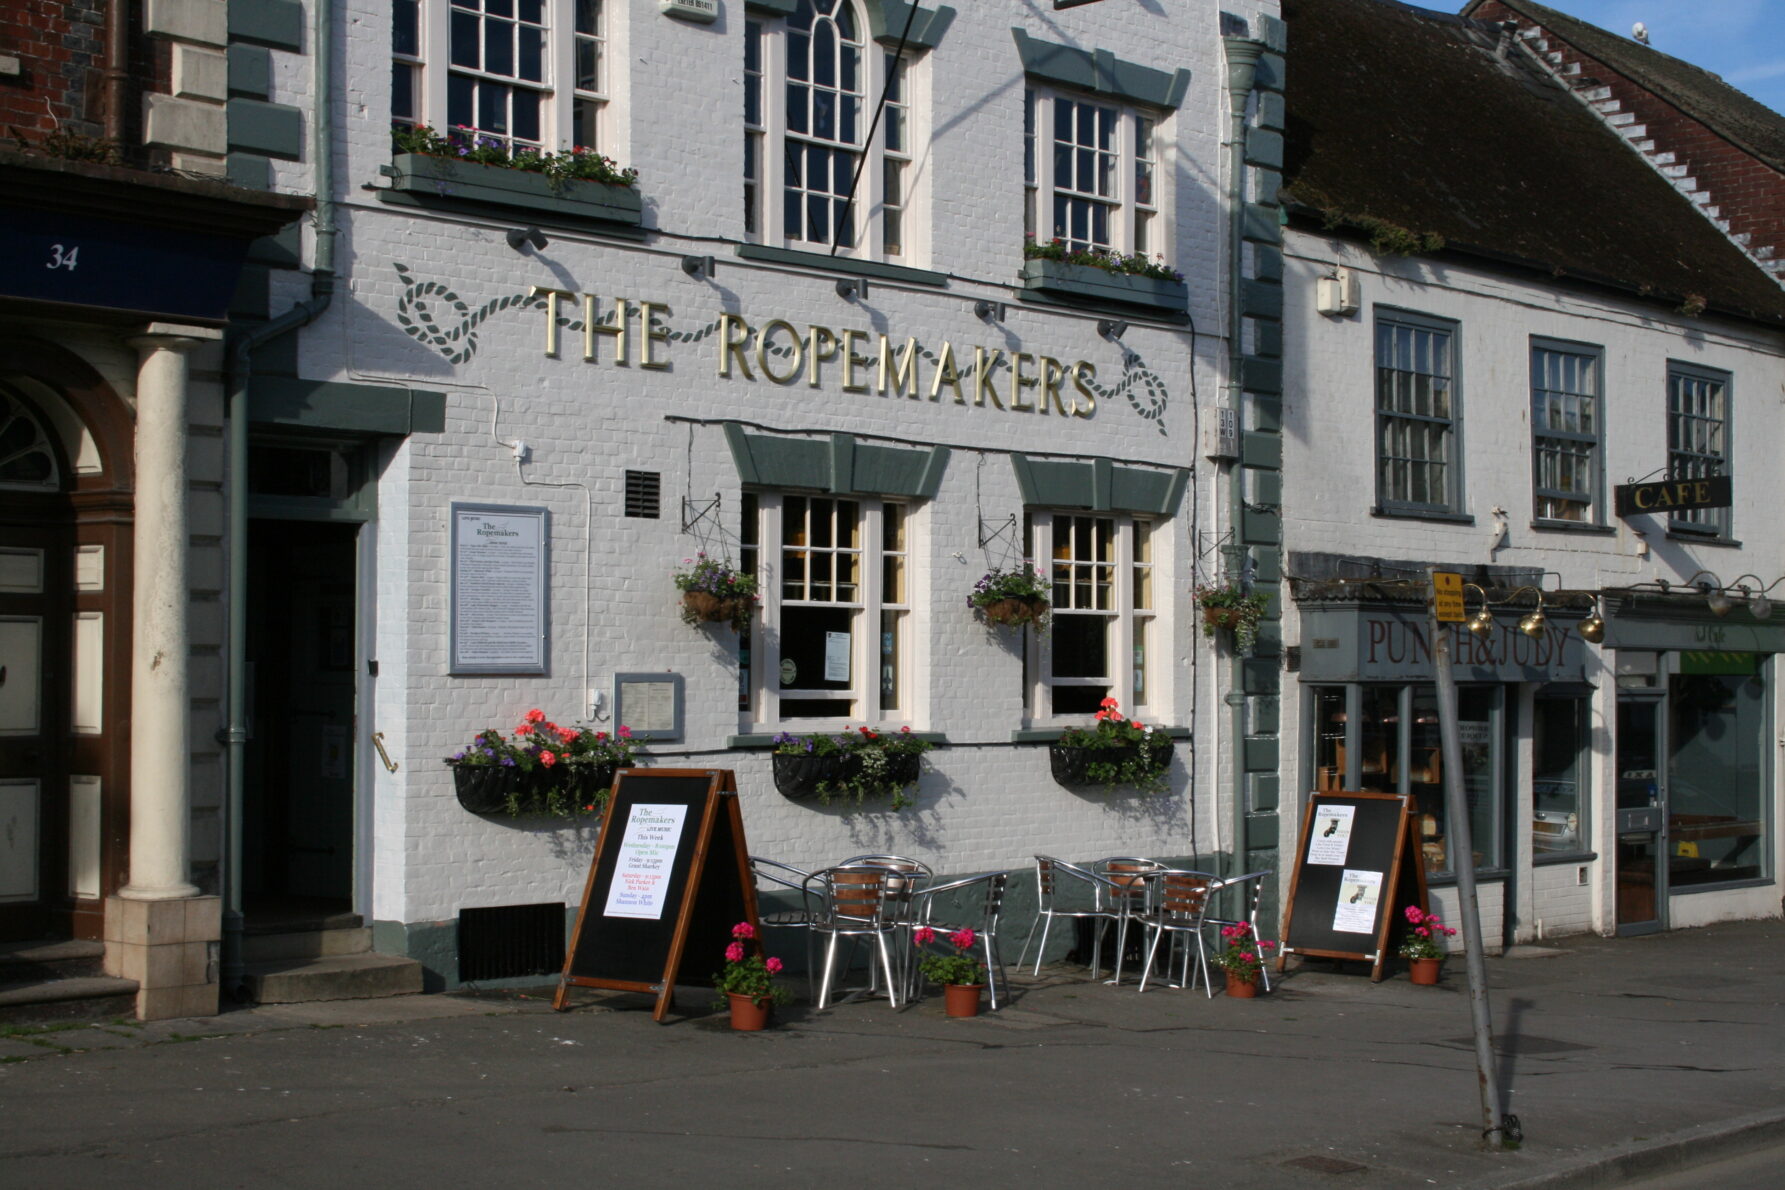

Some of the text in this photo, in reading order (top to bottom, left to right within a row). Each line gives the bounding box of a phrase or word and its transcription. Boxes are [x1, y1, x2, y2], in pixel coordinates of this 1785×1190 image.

[46, 244, 79, 271] 34
[530, 286, 1098, 418] THE ROPEMAKERS
[1634, 481, 1712, 509] CAFE
[476, 528, 519, 538] Ropemakers
[1367, 619, 1570, 668] PUNH&JUDY
[631, 815, 675, 825] Ropemakers
[639, 808, 652, 816] The
